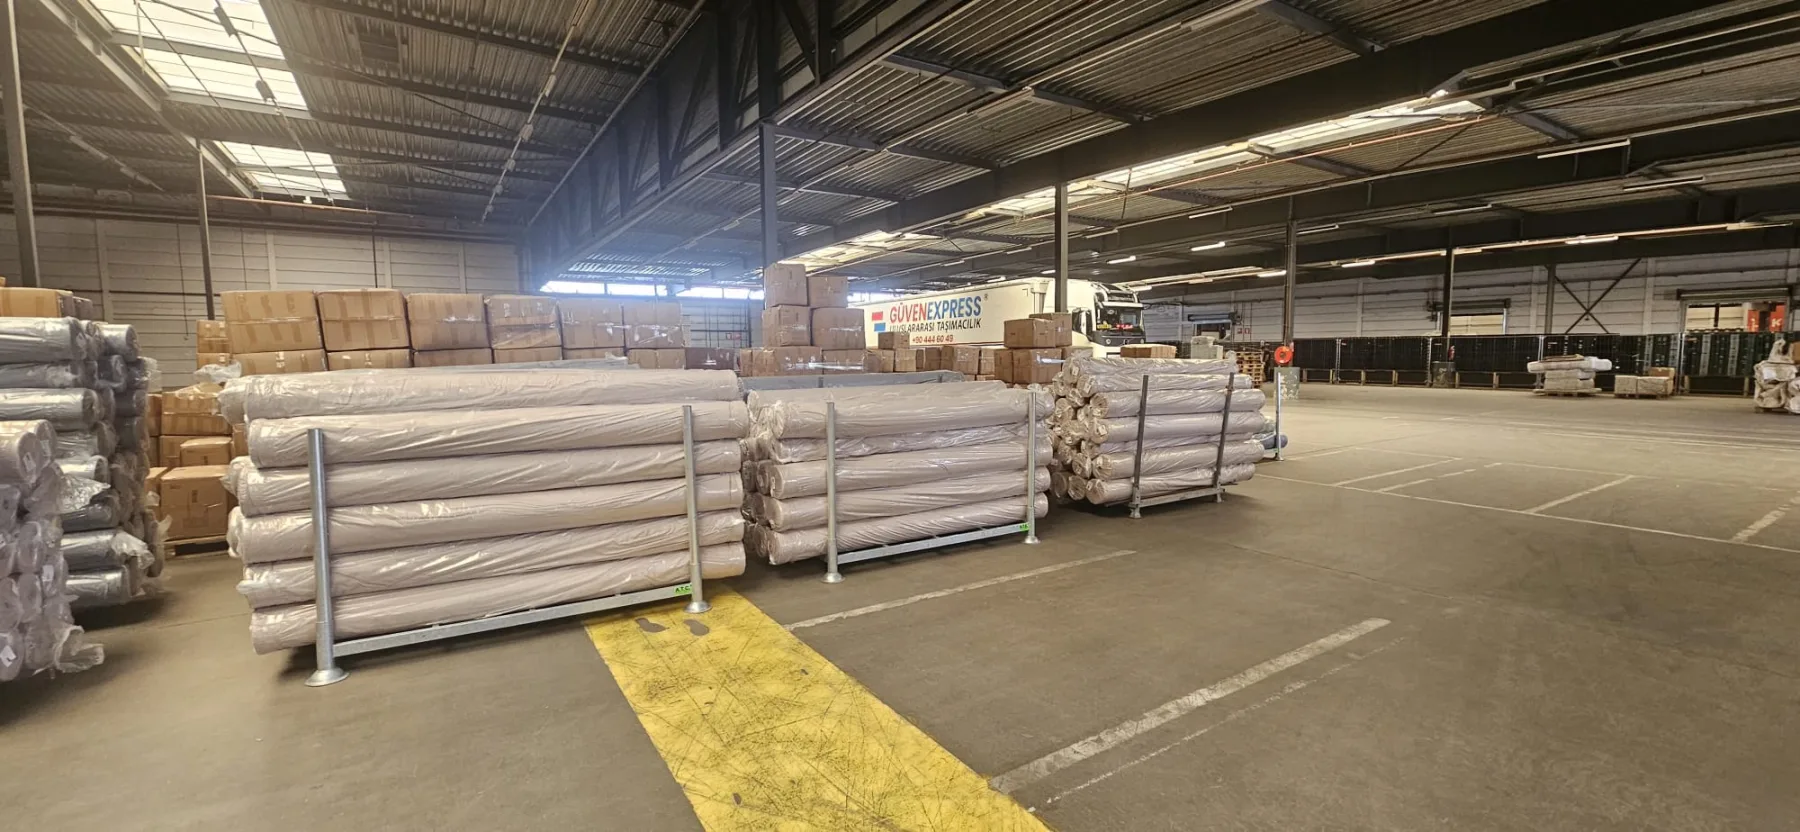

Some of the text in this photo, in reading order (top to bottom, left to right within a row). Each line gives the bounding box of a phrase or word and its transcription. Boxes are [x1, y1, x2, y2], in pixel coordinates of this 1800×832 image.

[889, 296, 981, 323] GÜVENEXPRESS
[937, 318, 981, 333] TAŞIMACILIK
[912, 336, 923, 344] +90
[924, 335, 935, 343] 444
